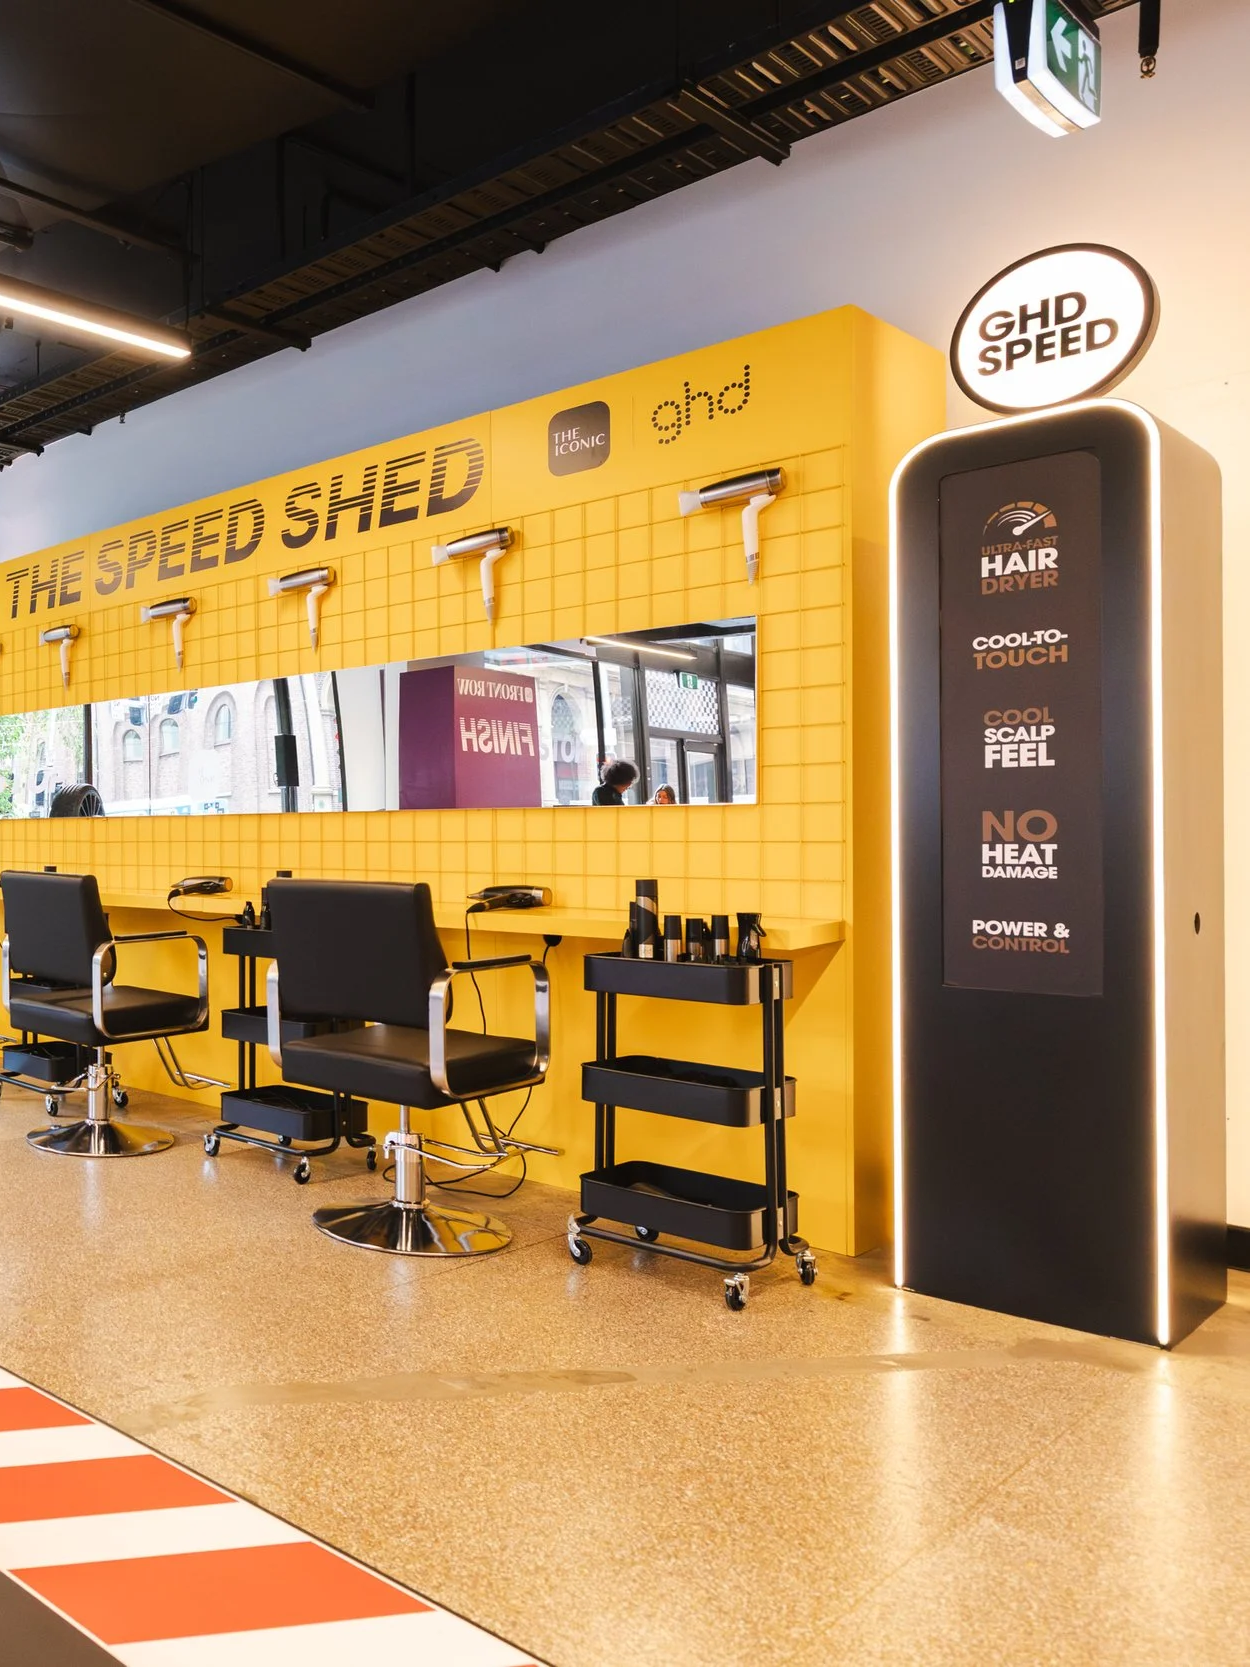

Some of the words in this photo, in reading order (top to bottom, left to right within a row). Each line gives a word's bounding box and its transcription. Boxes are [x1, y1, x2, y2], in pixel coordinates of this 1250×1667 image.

[978, 291, 1087, 343] GHD
[977, 317, 1119, 377] SPEED
[651, 364, 750, 444] ghd
[552, 426, 581, 445] THE
[554, 432, 606, 457] ICONIC
[6, 550, 85, 619] THE
[94, 498, 265, 596] SPEED
[281, 437, 485, 549] SHED
[981, 535, 1059, 556] ULTRA-FAST
[981, 547, 1059, 578] HAIR
[981, 570, 1059, 595] DRYER
[972, 628, 1069, 651] COOL-TO-
[972, 644, 1069, 670] TOUCH
[983, 706, 1054, 727] COOL
[984, 724, 1056, 743] SCALP
[984, 742, 1056, 768] FEEL
[982, 809, 1058, 842] NO
[982, 843, 1058, 865] HEAT
[981, 866, 1058, 879] DAMAGE
[972, 919, 1048, 938] POWER
[1053, 922, 1070, 938] &
[972, 935, 1070, 954] CONTROL
